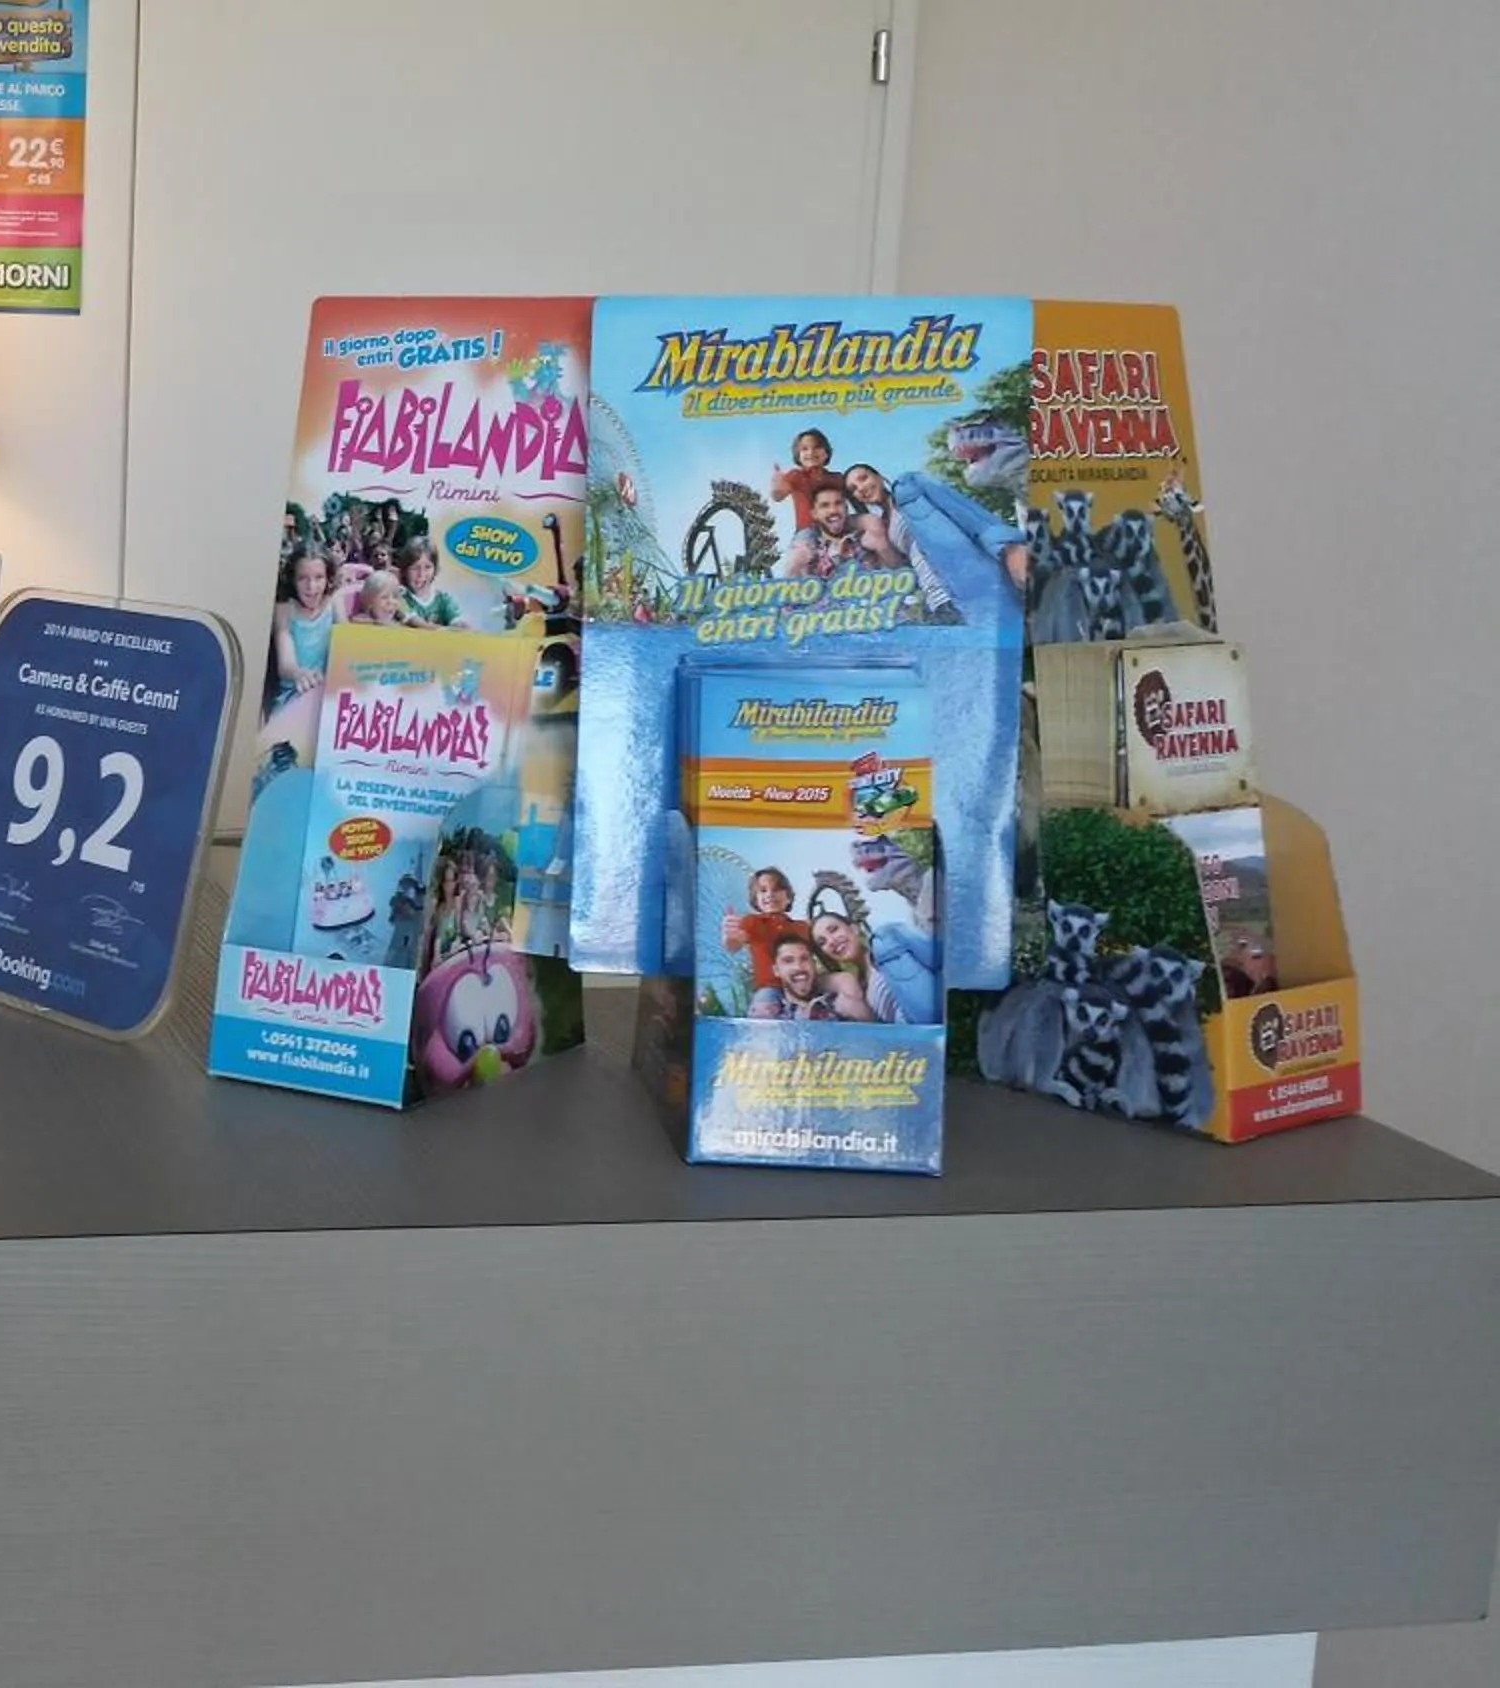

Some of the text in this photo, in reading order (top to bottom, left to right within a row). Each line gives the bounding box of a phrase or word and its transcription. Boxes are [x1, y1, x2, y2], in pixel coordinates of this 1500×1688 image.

[6, 17, 64, 36] questo
[7, 84, 23, 94] AL
[25, 84, 66, 97] PARCO
[324, 328, 437, 356] il giorno dopo
[356, 347, 393, 367] entri
[397, 337, 486, 370] GRATIS
[636, 314, 982, 395] Mirabilandia
[1030, 348, 1161, 403] SAFARI
[707, 383, 839, 412] divertimento
[844, 382, 875, 406] più
[1028, 405, 1180, 460] RAVENNA
[426, 479, 502, 503] Rimini
[469, 525, 518, 545] SHOW
[455, 540, 524, 566] dal VIVO
[712, 575, 823, 618] giorno
[830, 562, 916, 606] dopo
[695, 594, 901, 647] entri gratis!
[43, 622, 174, 655] 2014 AWARD OF EXCELLENCE
[18, 662, 181, 711] Camera & Caffè Cenni
[45, 704, 88, 724] HONOURED
[116, 717, 149, 735] GUESTS
[728, 696, 898, 728] Mirabilandia
[1162, 698, 1227, 729] SAFARI
[1156, 728, 1239, 761] RAVENNA
[6, 734, 145, 873] 9,2
[337, 778, 353, 791] LA
[354, 780, 406, 797] RISERVA
[347, 794, 371, 808] DEL
[707, 785, 752, 800] Novità
[763, 786, 794, 801] New
[795, 787, 831, 801] 2015
[1282, 1002, 1340, 1036] SAFARI
[270, 1032, 358, 1059] 0541 372064
[1276, 1027, 1345, 1061] RAVENNA
[246, 1048, 371, 1080] www.fiabilandia.it
[713, 1048, 929, 1090] Mirabilandia
[734, 1126, 899, 1154] mirabilandia.it
